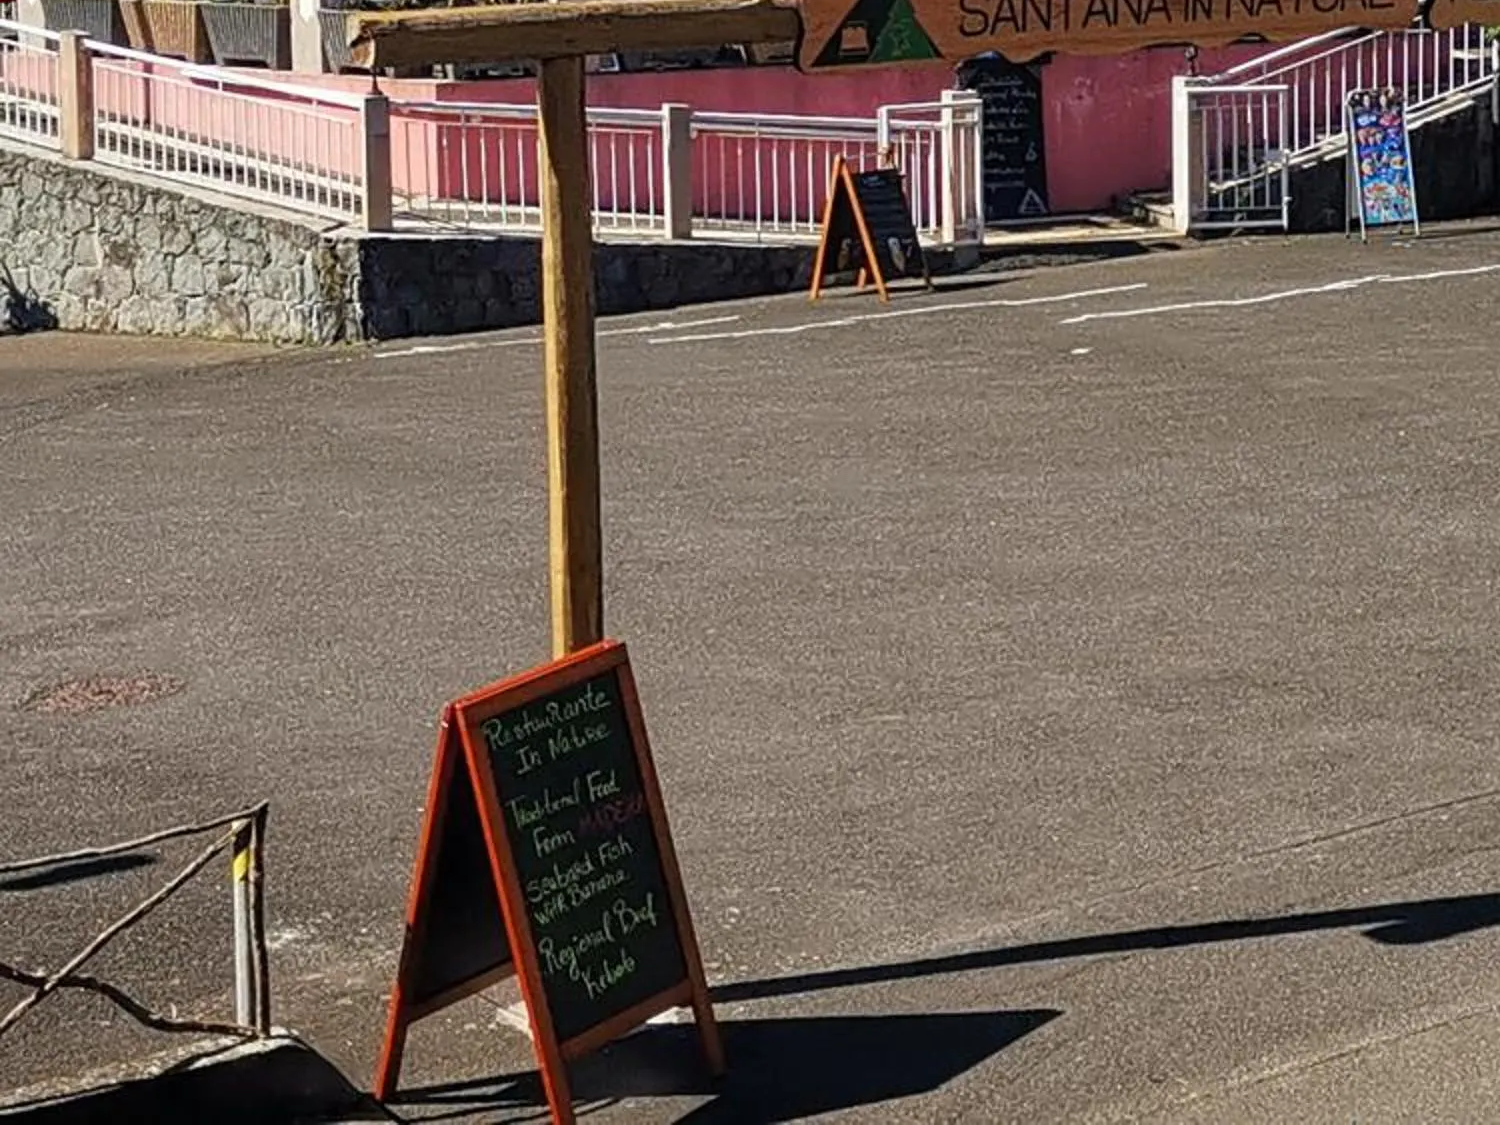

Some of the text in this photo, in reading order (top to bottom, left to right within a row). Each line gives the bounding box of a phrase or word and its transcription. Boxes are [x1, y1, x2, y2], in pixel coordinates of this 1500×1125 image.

[515, 746, 543, 775] In
[587, 769, 621, 803] Food
[538, 911, 616, 982] Regional
